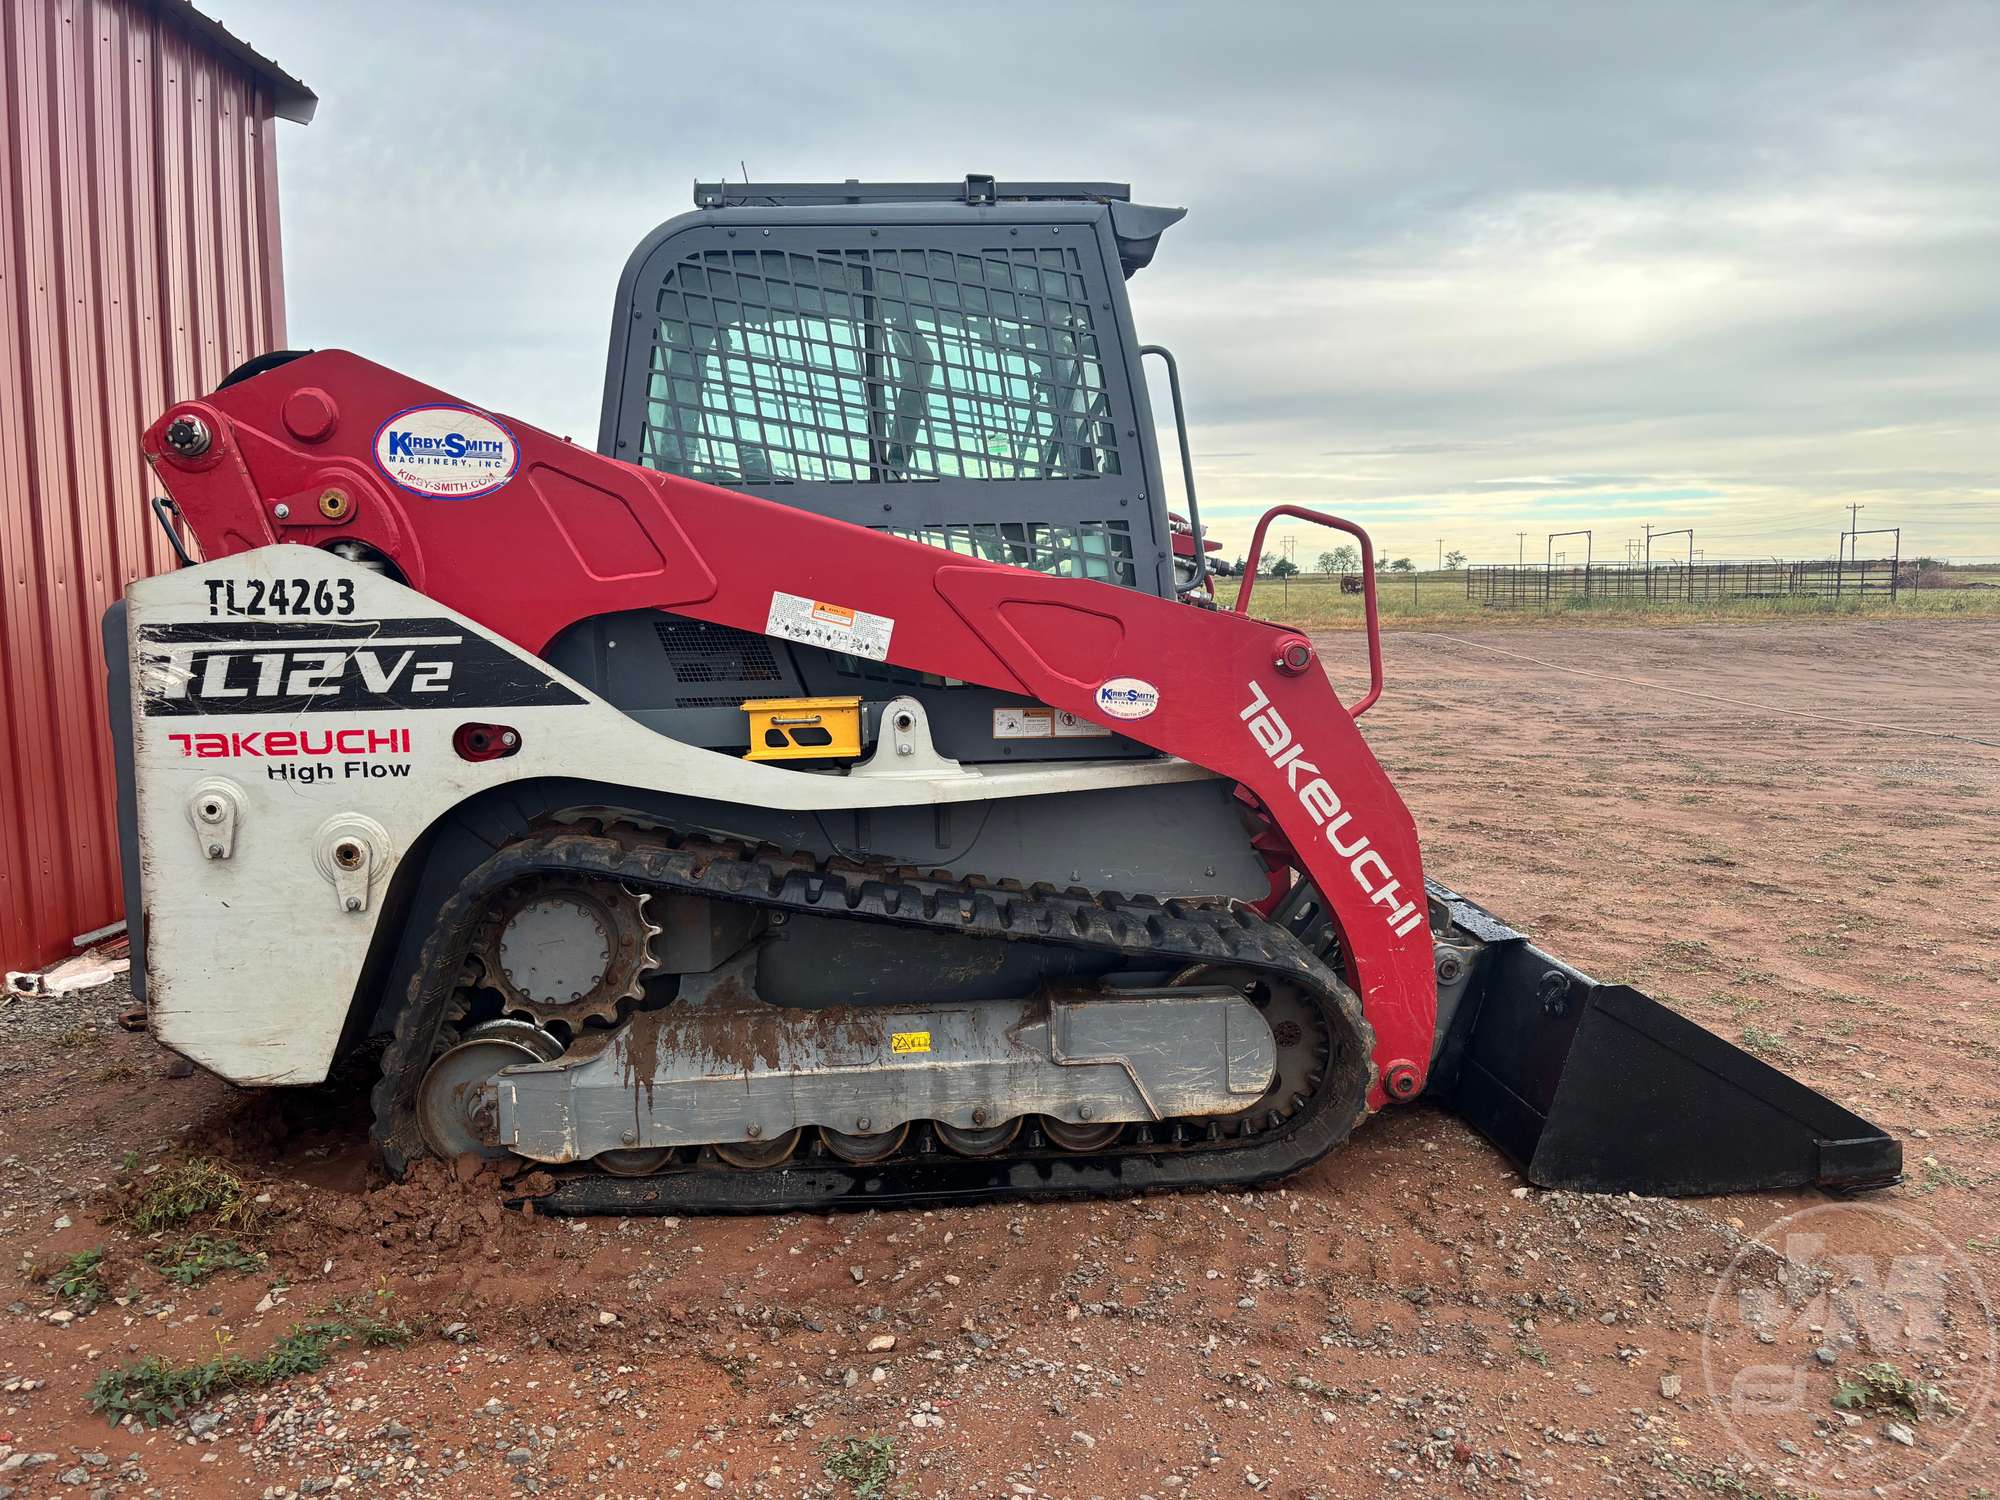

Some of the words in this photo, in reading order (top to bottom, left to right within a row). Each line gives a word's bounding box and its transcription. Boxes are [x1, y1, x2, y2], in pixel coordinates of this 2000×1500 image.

[389, 456, 472, 468] MACHINERY,
[205, 579, 355, 616] TL24263
[267, 764, 334, 784] High
[344, 764, 412, 780] Flow
